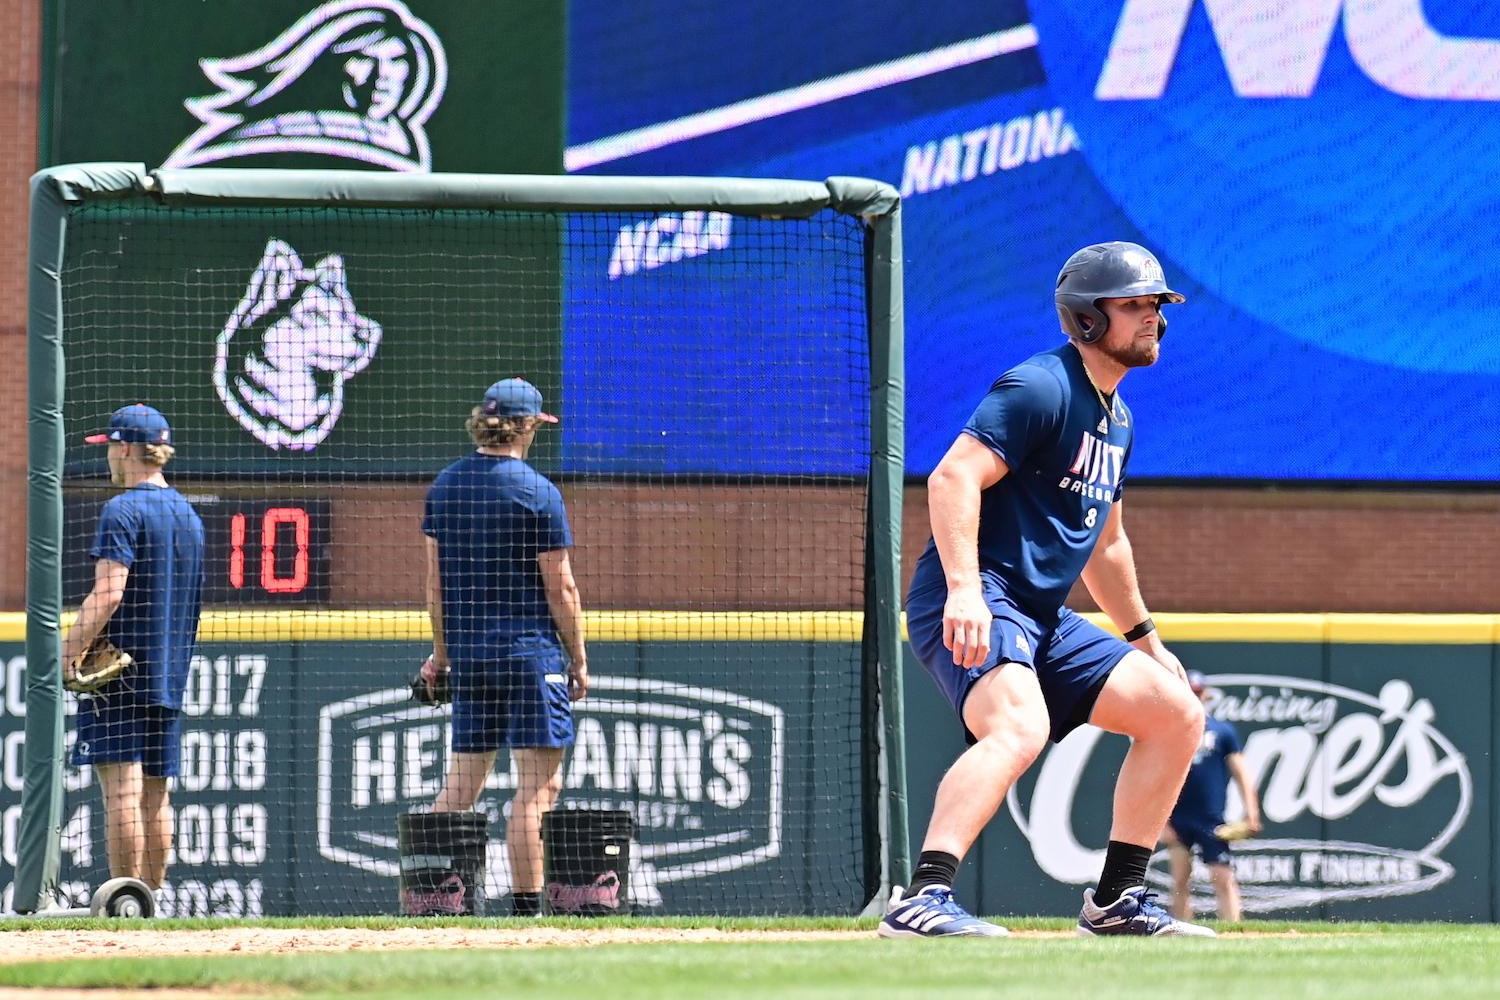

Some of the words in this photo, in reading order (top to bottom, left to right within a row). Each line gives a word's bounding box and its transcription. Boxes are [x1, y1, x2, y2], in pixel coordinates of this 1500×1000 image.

[606, 210, 734, 280] NCAA
[1057, 476, 1114, 504] BASEBA
[1084, 507, 1098, 528] 8
[229, 507, 310, 593] 10
[182, 653, 268, 717] 017
[167, 729, 267, 791] 018
[350, 711, 753, 810] HEANN'S
[1029, 679, 1440, 884] Cne's
[168, 802, 268, 867] 019
